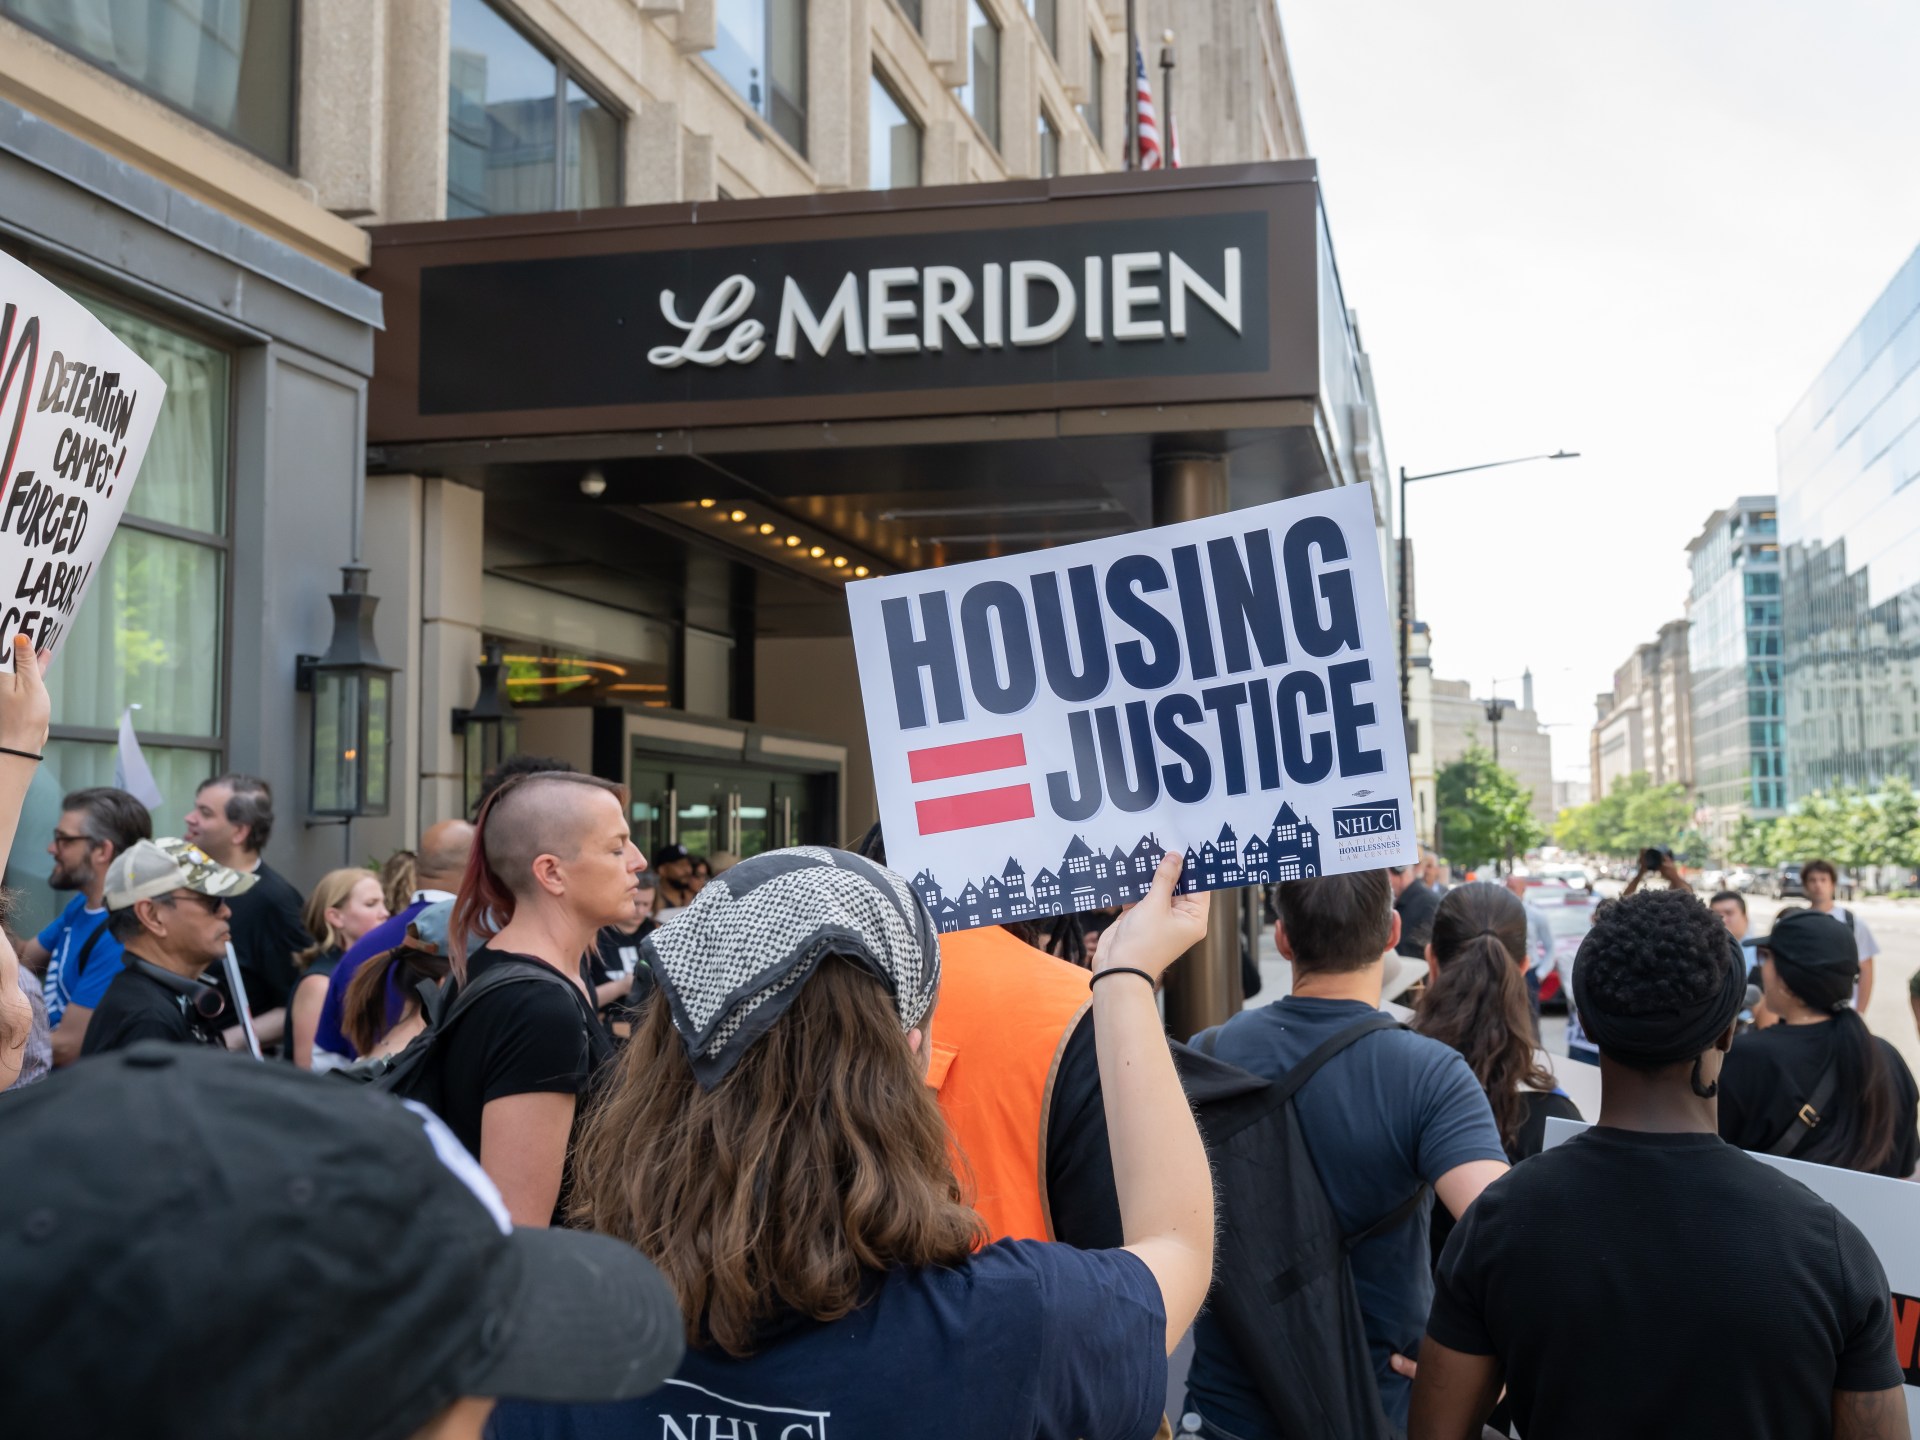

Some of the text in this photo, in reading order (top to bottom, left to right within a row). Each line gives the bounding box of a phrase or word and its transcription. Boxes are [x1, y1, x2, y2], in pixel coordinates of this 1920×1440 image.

[648, 247, 1242, 368] Le MERIDIEN
[53, 428, 127, 499] CAMPS!
[1, 471, 88, 555] FORCED
[15, 558, 92, 617] LABOR!
[881, 515, 1361, 731] HOUSING
[1046, 658, 1385, 823] JUSTICE
[1336, 813, 1393, 836] NHLC
[1338, 834, 1400, 847] NATIONAL
[1339, 841, 1400, 855] HOMELESSNESS
[1364, 848, 1401, 858] CENTER
